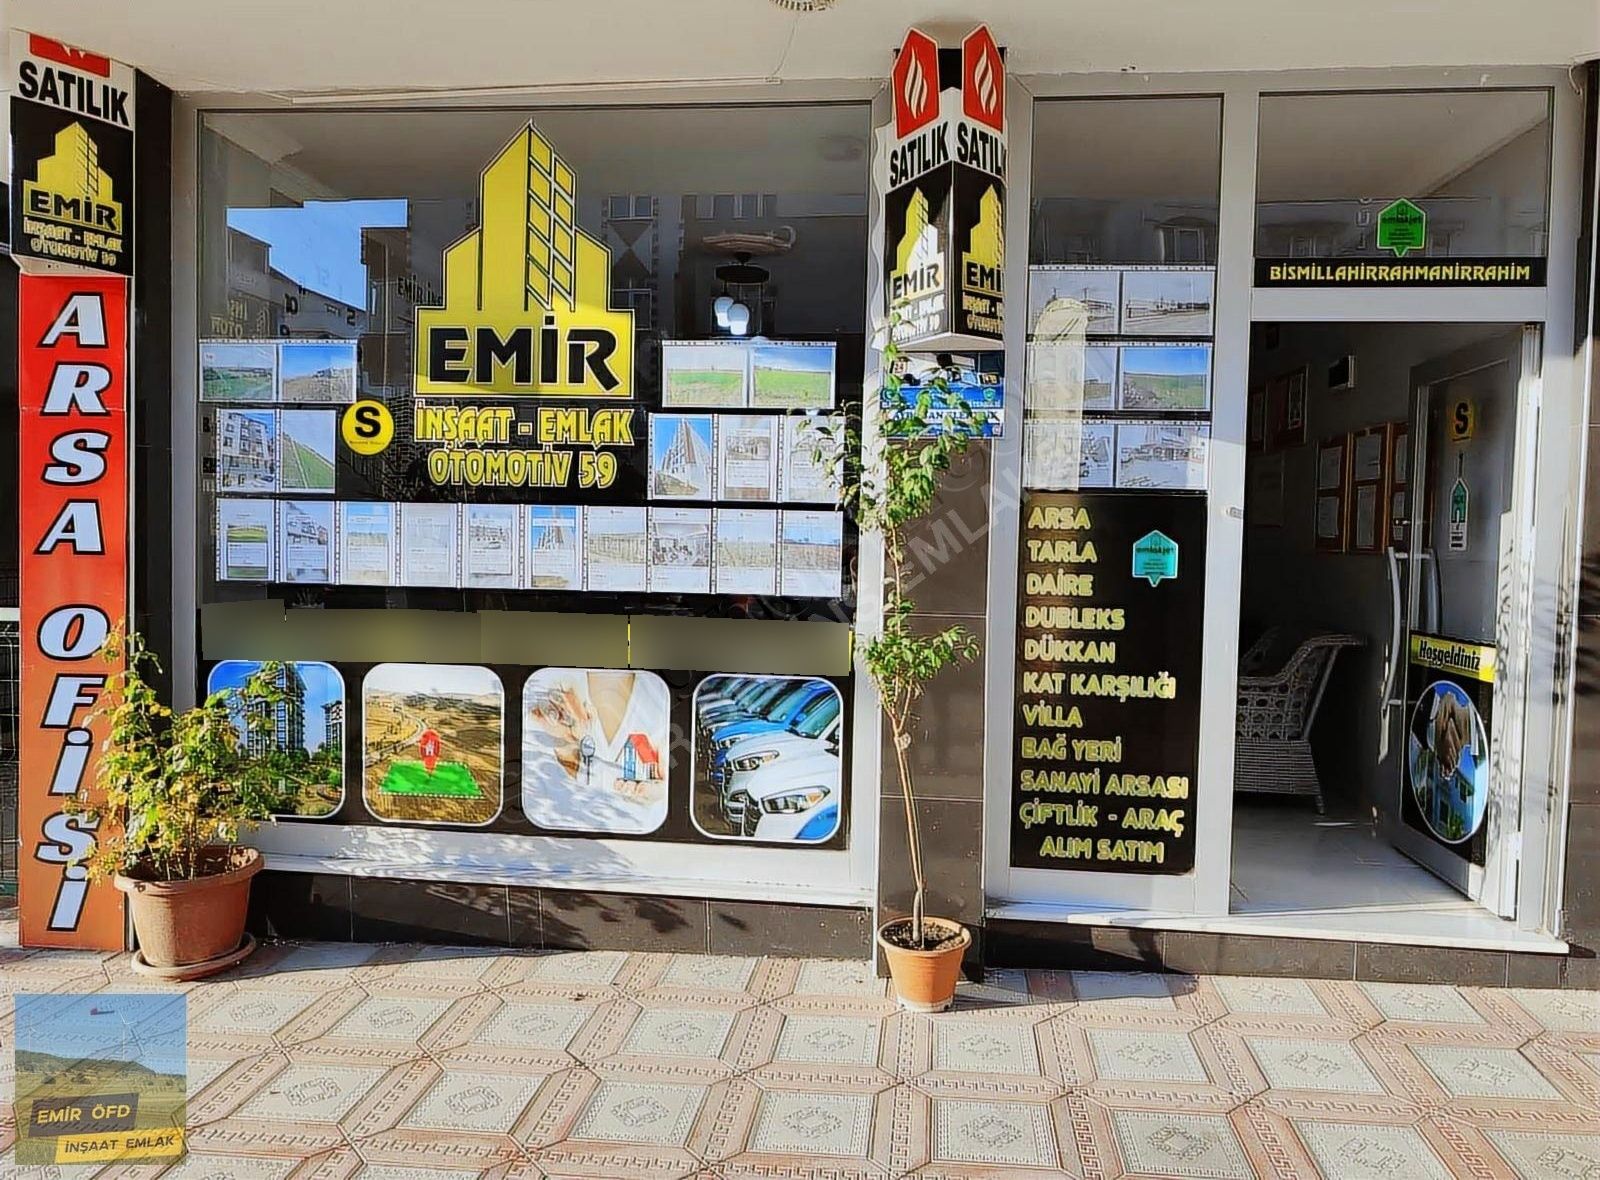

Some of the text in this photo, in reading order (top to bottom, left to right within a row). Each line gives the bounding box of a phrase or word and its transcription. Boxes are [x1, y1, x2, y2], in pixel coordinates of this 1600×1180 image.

[18, 60, 129, 126] SATILIK
[889, 121, 950, 188] SATILIK
[30, 189, 117, 232] EMİR
[893, 262, 940, 299] EMİR
[966, 261, 1003, 293] EMİ
[1270, 262, 1530, 281] BİSMİLLAHİRRAHMANİRRAHİM
[427, 315, 622, 392] EMİR
[37, 291, 112, 555] ARSA
[355, 405, 381, 438] S
[414, 399, 514, 450] İNŞAAT
[538, 407, 634, 450] EMLAK
[1454, 402, 1469, 435] S
[427, 443, 617, 489] OTOMOTİV 59
[1028, 507, 1091, 530] ARSA
[1027, 540, 1097, 563] TARLA
[1025, 568, 1093, 596] DAİRE
[1025, 606, 1125, 630] DUBLEKS
[1024, 634, 1116, 663] DÜKKAN
[1023, 671, 1176, 702] KAT KARŞILIĞI
[1022, 700, 1083, 728] VİLLA
[1021, 733, 1122, 763] BAĞ YERİ
[1020, 768, 1189, 800] SANAYİ ARSASI
[1019, 798, 1185, 837] ÇİFTLİK - ARAÇ
[1039, 836, 1165, 864] ALIM SATIM
